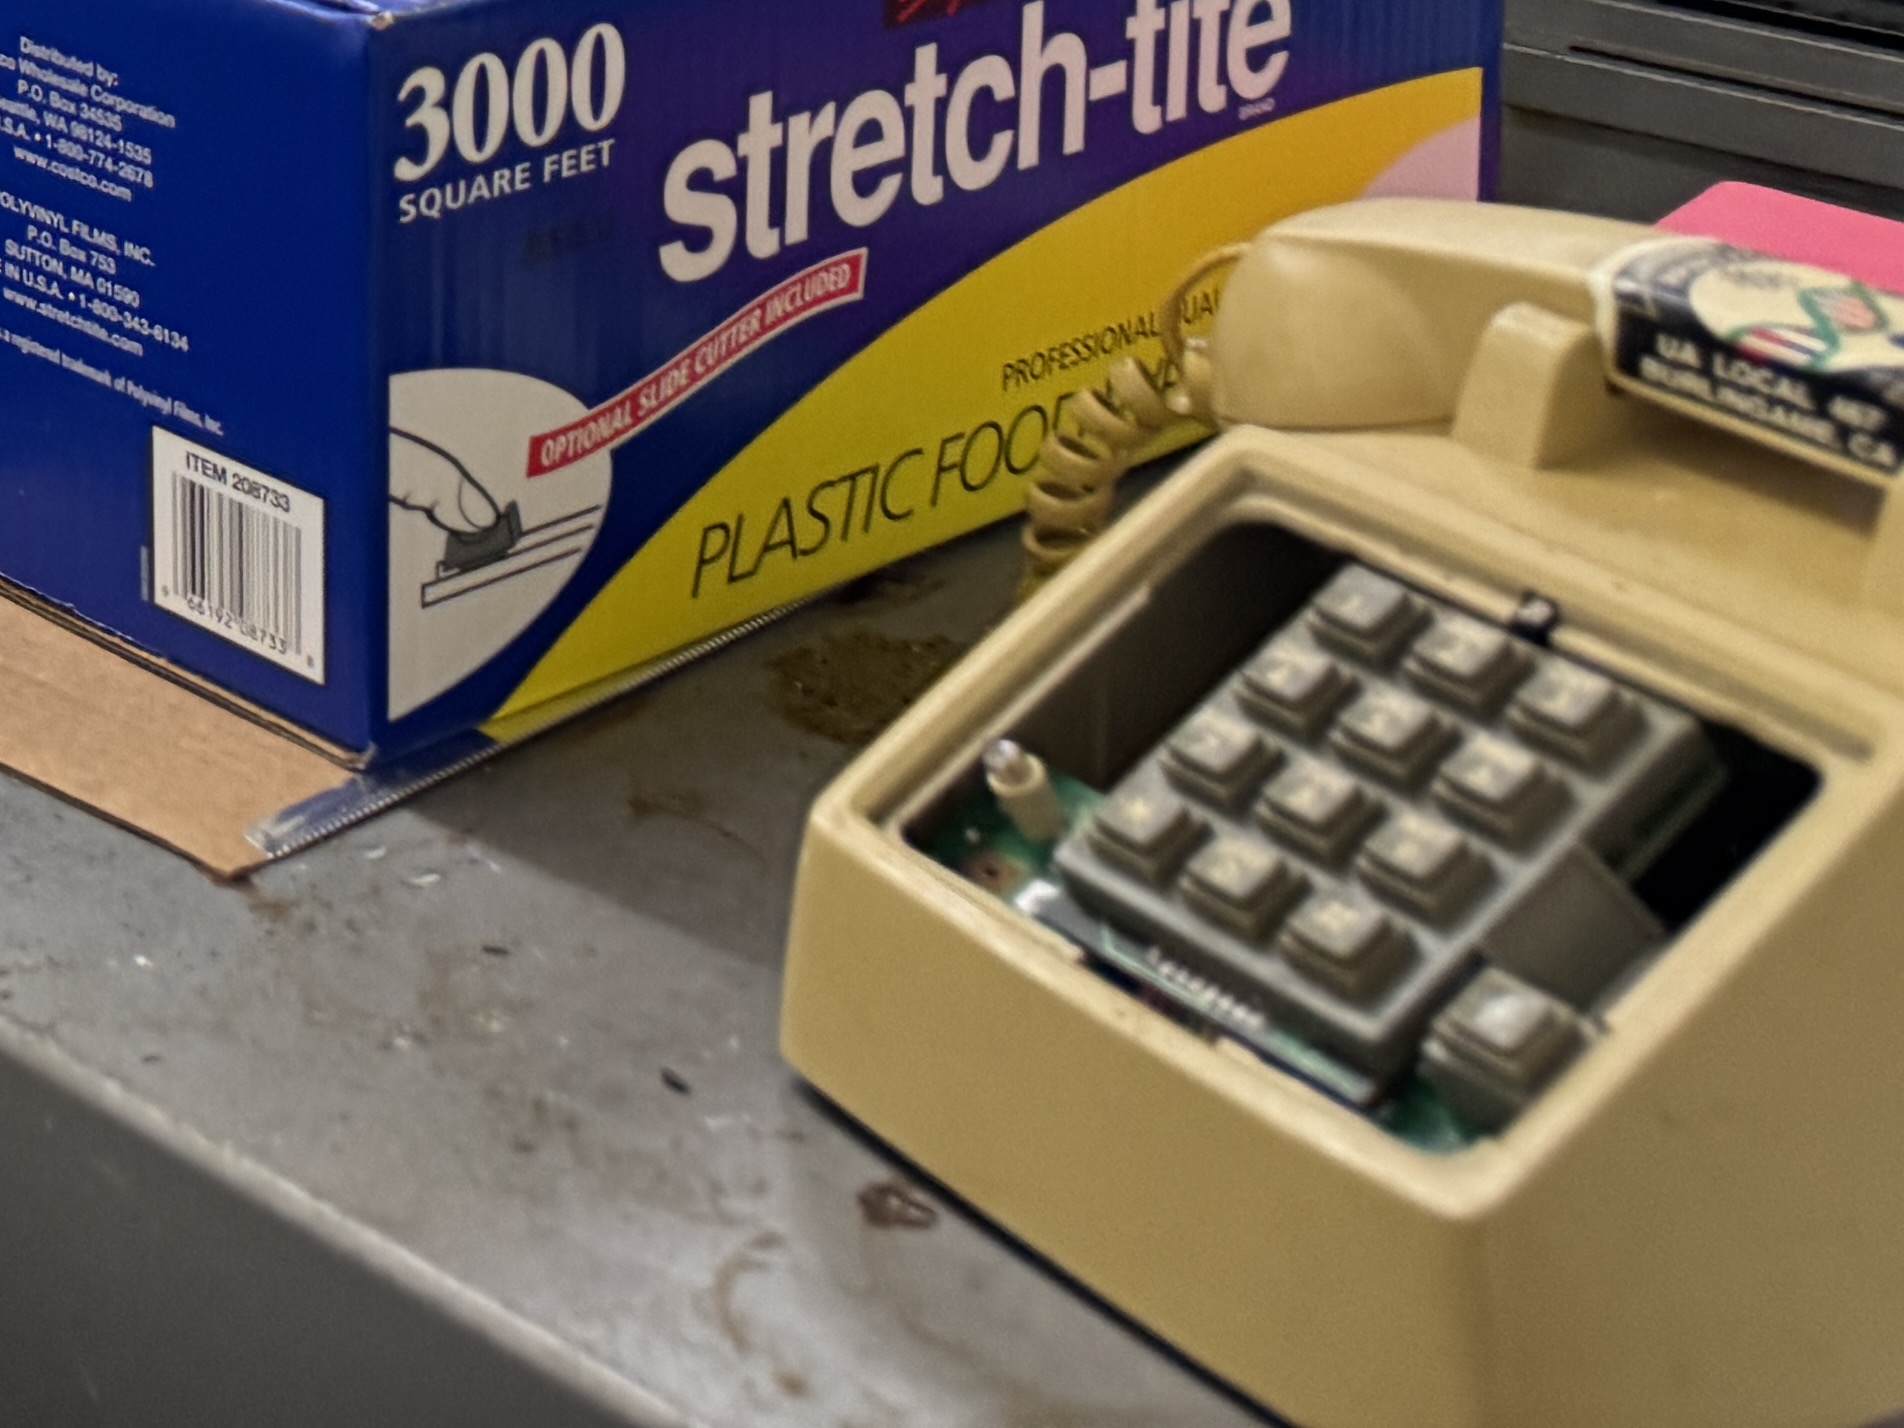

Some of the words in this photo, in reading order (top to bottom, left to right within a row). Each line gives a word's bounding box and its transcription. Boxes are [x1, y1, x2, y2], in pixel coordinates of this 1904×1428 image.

[18, 57, 89, 97] Wholesale
[91, 84, 176, 129] Corporation
[19, 35, 94, 77] Distributed
[96, 61, 119, 88] by:
[17, 78, 45, 104] P.O.
[48, 90, 76, 115] Box
[79, 102, 123, 131] 34535
[394, 22, 626, 182] 3000
[43, 110, 68, 134] WA
[70, 119, 152, 165] 98124-1535
[45, 133, 154, 189] 1-800-774-2678
[13, 145, 132, 202] www.costco.com
[399, 161, 531, 223] SQUARE
[543, 138, 615, 183] FEET
[4, 239, 67, 280] SUTTON,
[70, 266, 94, 289] MA
[96, 278, 141, 308] 01590
[27, 224, 57, 251] P.O.
[59, 238, 88, 263] Box
[90, 249, 117, 275] 753
[71, 219, 121, 256] FILMS,
[123, 240, 156, 267] INC.
[3, 286, 143, 357] www.stretchtite.com
[4, 261, 20, 282] IN
[22, 268, 64, 300] U.S.A.
[80, 293, 190, 352] 1-800-343-6134
[541, 401, 632, 467] OPTIONAL
[637, 358, 690, 417] SLIDE
[693, 308, 762, 374] CUTTER
[765, 263, 851, 325] INCLUDED
[1002, 311, 1161, 392] PROFESSIONAL
[185, 451, 227, 485] ITEM
[232, 472, 291, 513] 208733
[691, 447, 924, 599] PLASTIC
